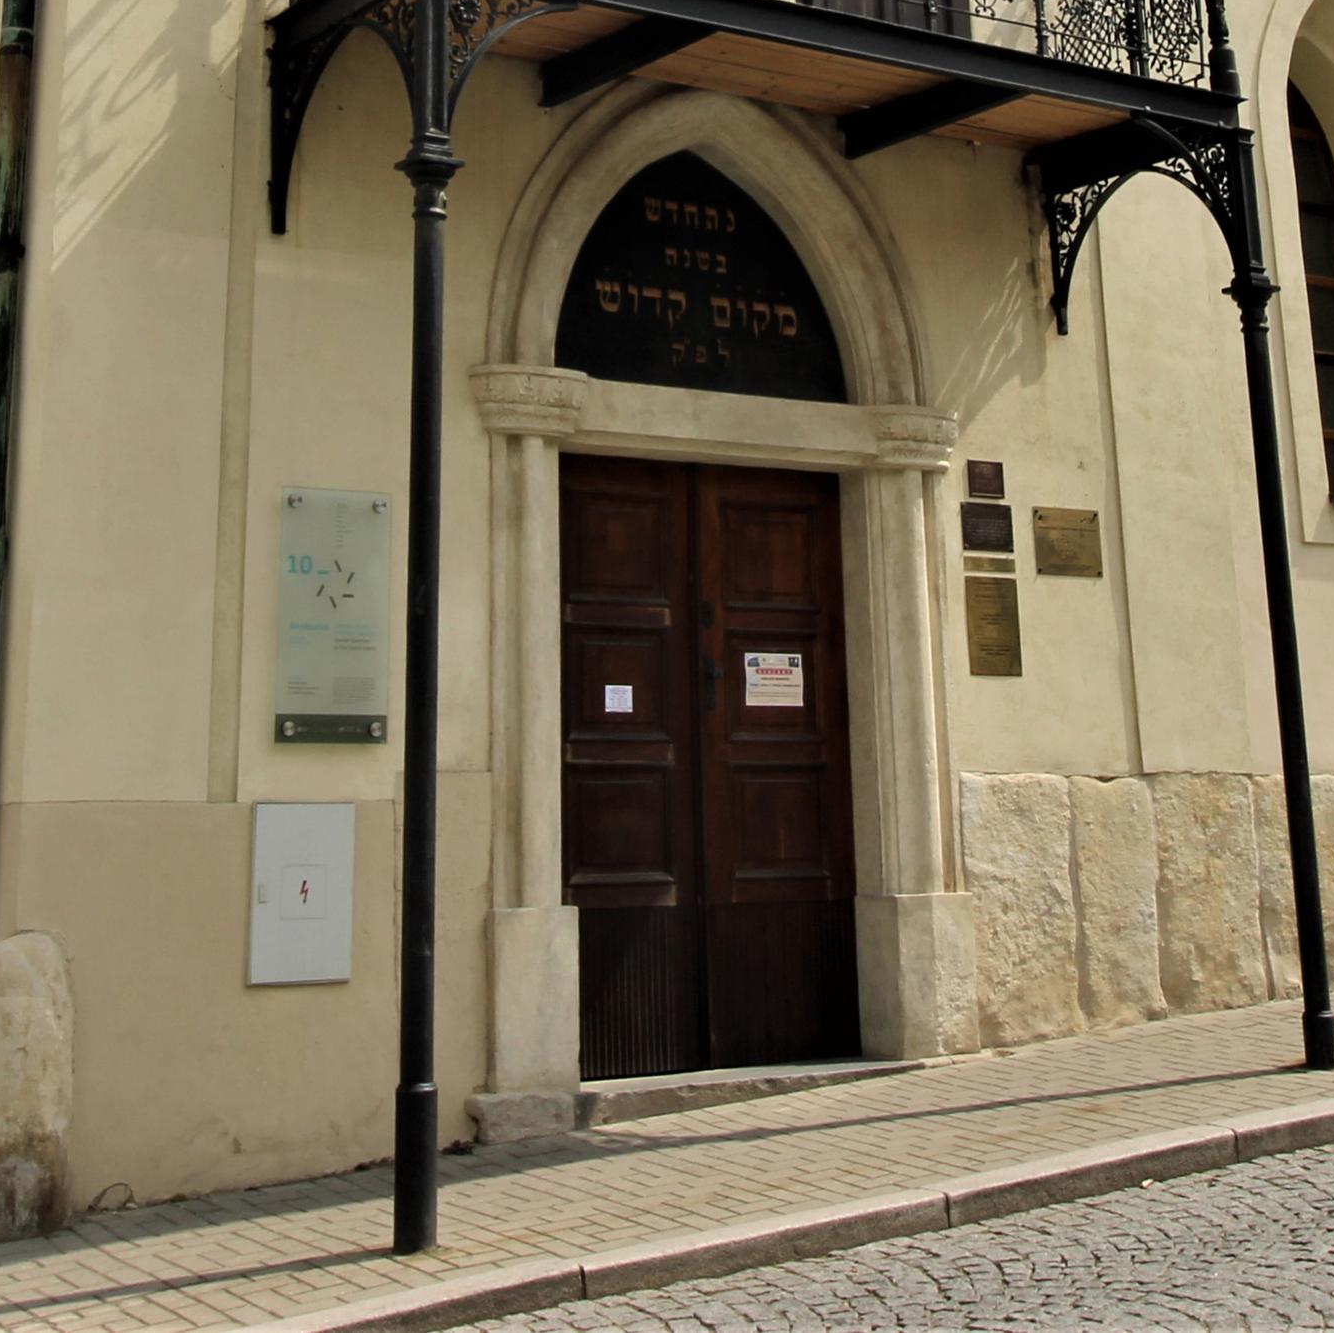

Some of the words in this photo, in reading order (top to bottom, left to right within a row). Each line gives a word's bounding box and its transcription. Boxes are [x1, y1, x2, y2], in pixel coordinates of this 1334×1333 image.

[665, 246, 728, 275] בשנה
[595, 278, 687, 330] קדוש
[710, 296, 798, 339] מקום
